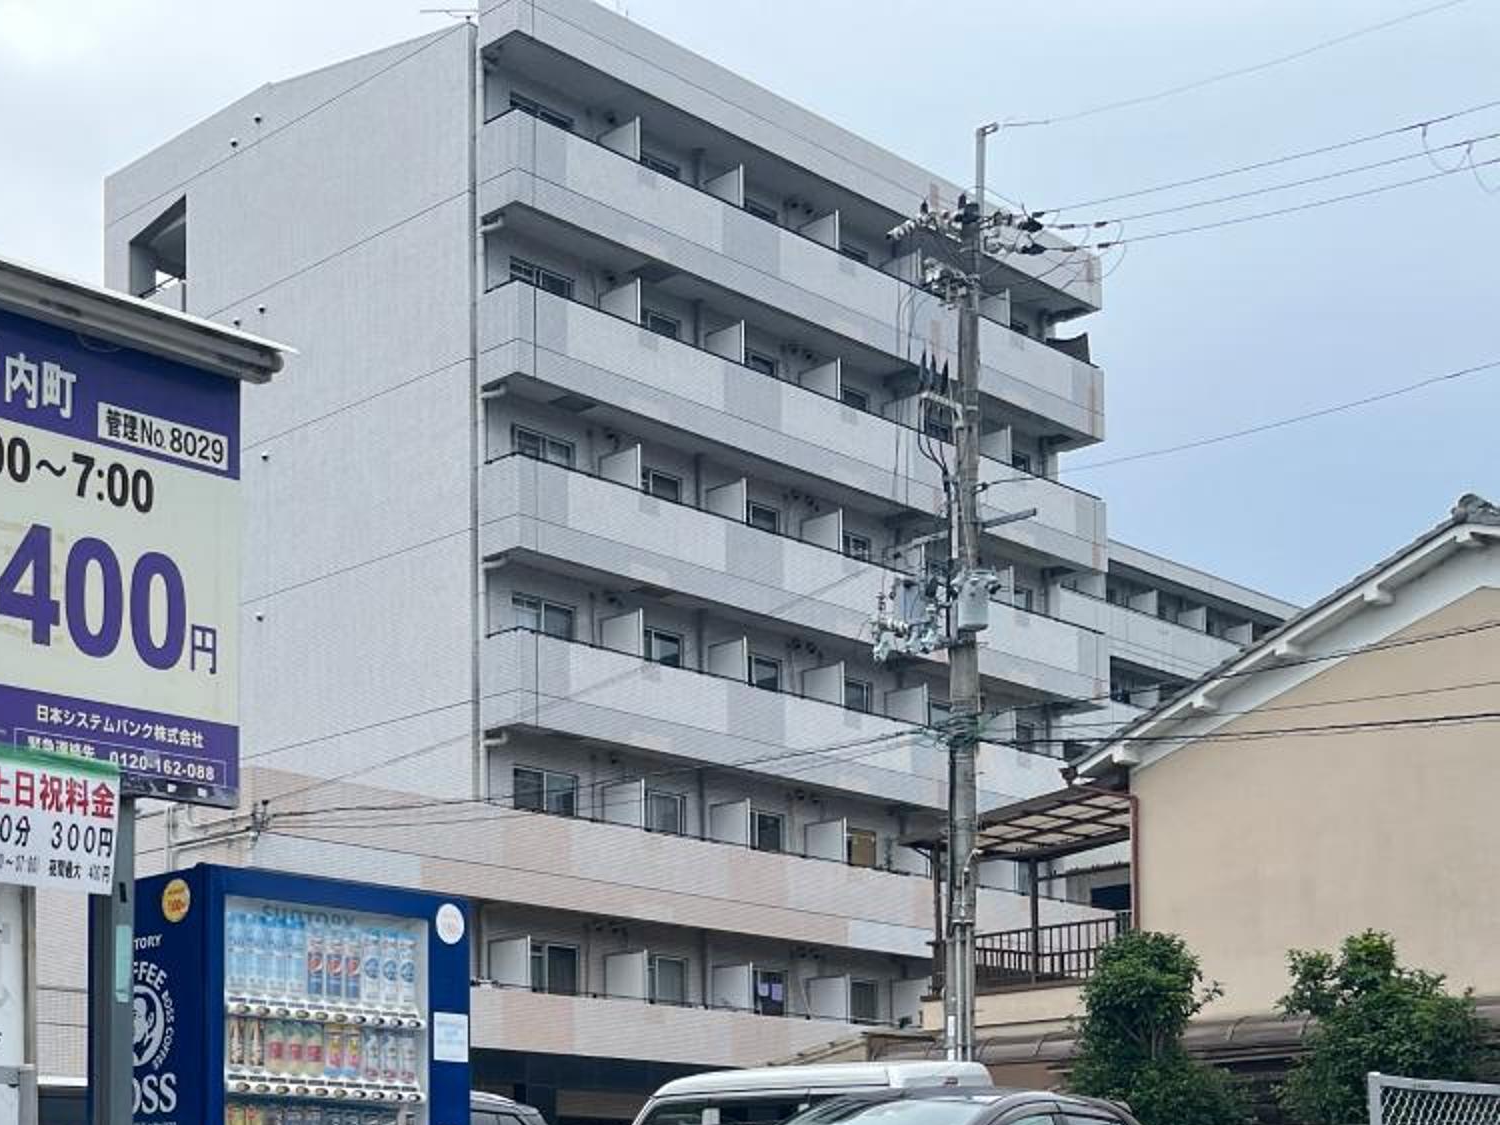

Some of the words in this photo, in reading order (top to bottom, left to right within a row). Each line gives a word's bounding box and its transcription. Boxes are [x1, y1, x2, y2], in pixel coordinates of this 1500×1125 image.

[36, 704, 204, 749] 日本システムバンク株式会社
[51, 821, 113, 858] 300円
